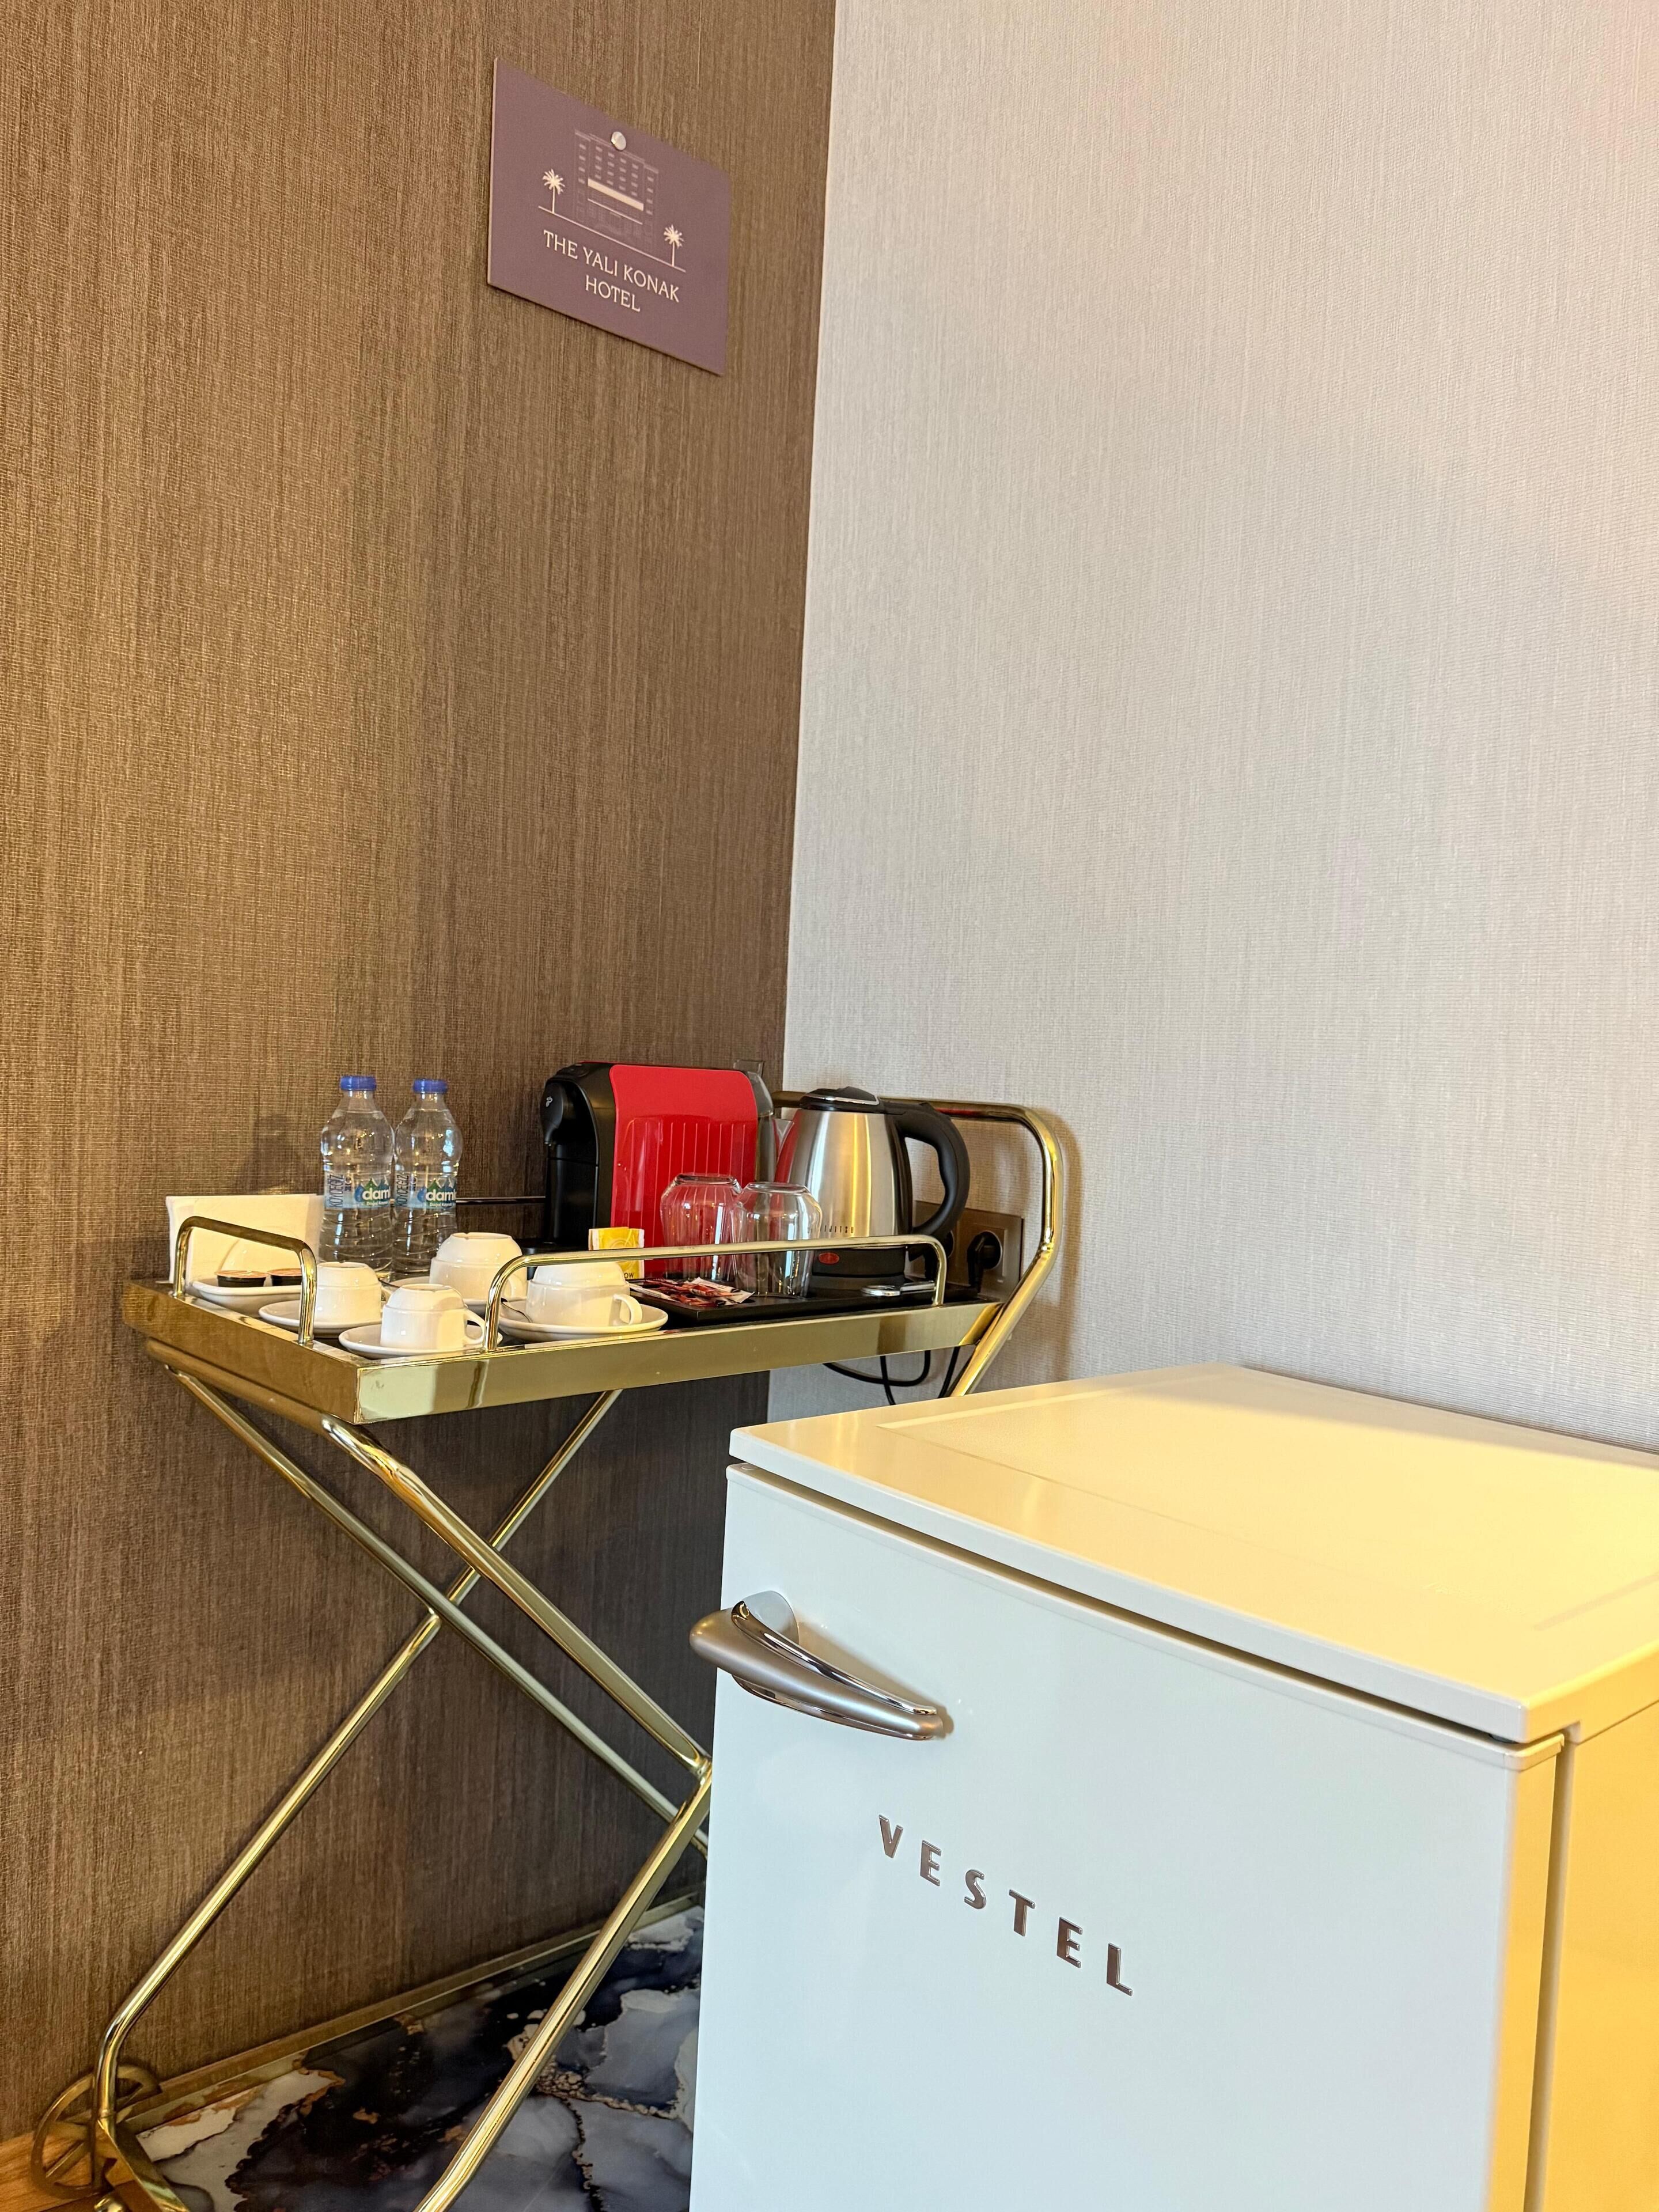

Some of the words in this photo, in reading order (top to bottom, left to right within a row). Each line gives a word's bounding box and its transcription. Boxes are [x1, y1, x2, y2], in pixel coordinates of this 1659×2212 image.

[543, 229, 578, 259] THE
[583, 247, 618, 276] YALI
[624, 264, 679, 302] KONAK
[585, 275, 641, 312] HOTEL
[878, 1814, 1132, 1996] VESTEL
